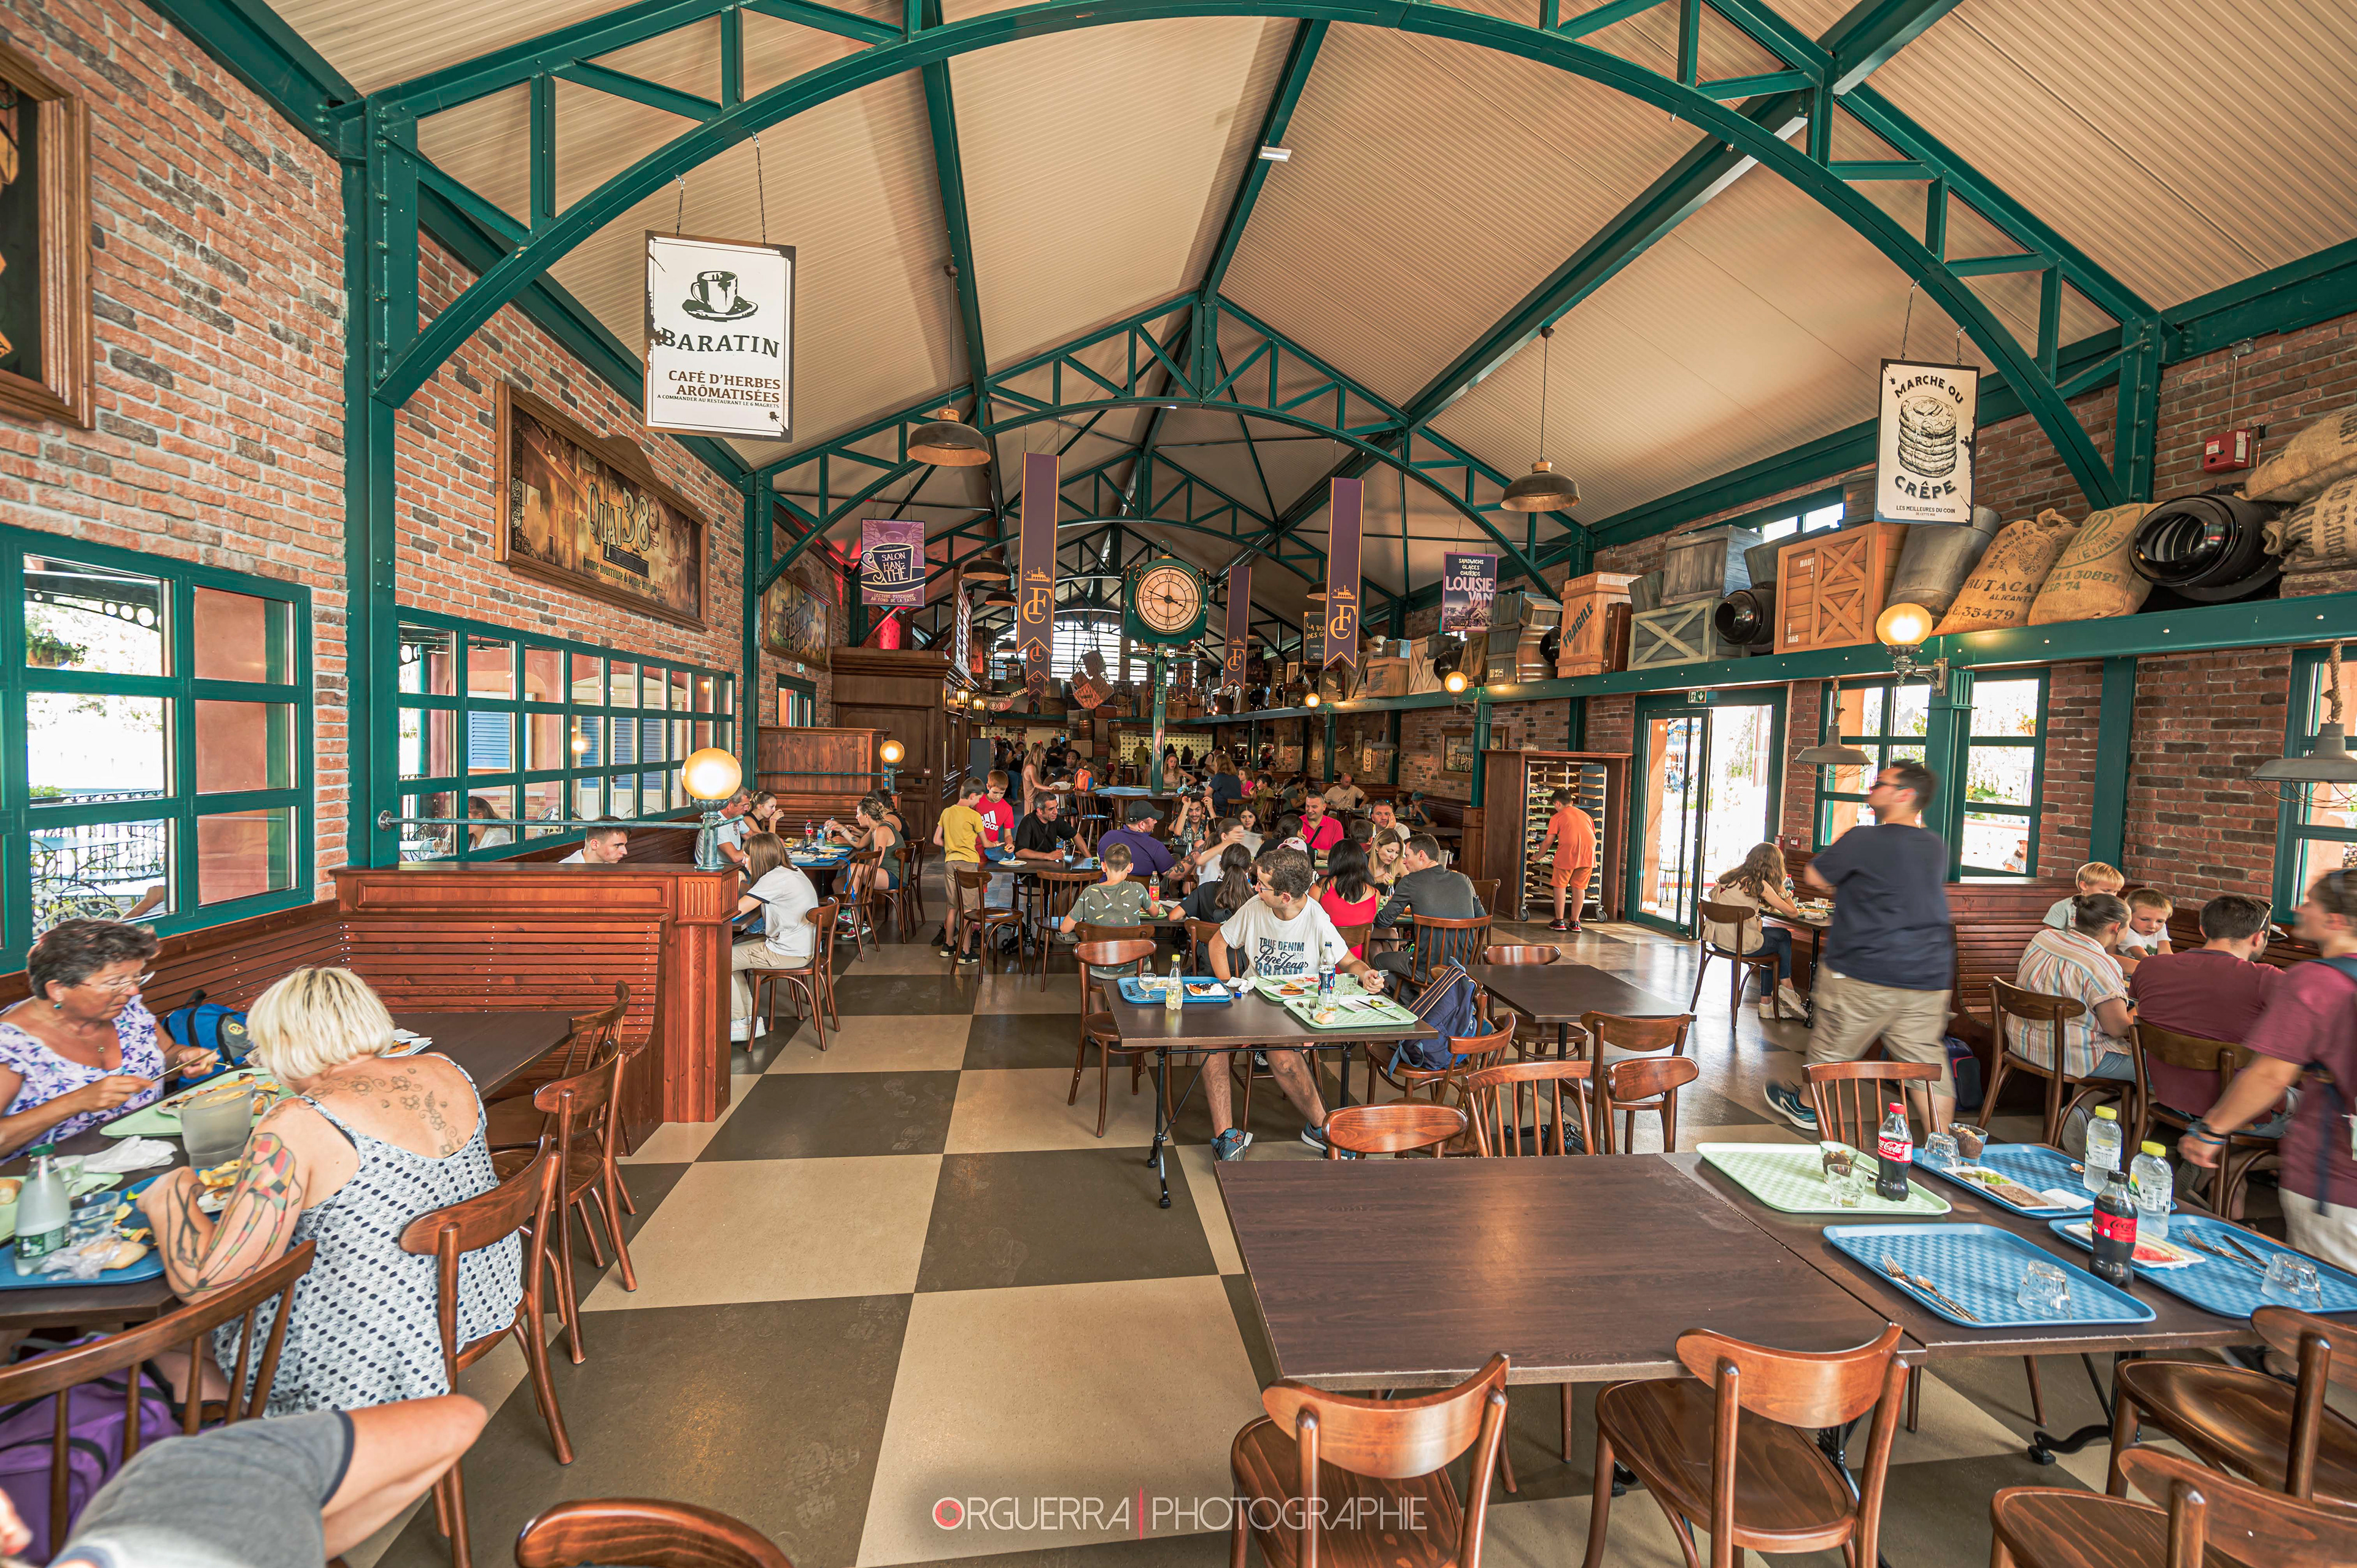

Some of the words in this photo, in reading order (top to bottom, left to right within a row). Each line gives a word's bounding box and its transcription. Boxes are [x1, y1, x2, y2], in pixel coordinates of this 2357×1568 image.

[661, 327, 780, 358] BARATIN
[668, 370, 705, 383] CAFÉ
[676, 384, 780, 403] ARÔMATISÉES
[1894, 376, 1945, 399] MARCHE
[1948, 385, 1964, 404] OU
[1895, 475, 1957, 499] CRÊPE
[587, 482, 622, 557] QUAI
[622, 487, 650, 551] 38
[881, 552, 906, 562] SALON
[584, 555, 599, 572] bonne
[600, 563, 623, 580] nourriture
[624, 572, 629, 582] &
[629, 573, 641, 588] bonne
[884, 565, 908, 582] THÉ
[1446, 576, 1495, 593] LOUISIE
[2065, 581, 2081, 591] 74
[1962, 606, 2015, 620] 35479
[1307, 622, 1314, 631] LA
[1563, 601, 1594, 648] FRAGILE
[1260, 937, 1277, 949] TRUE
[1278, 941, 1304, 952] DENIM
[1254, 945, 1282, 965] Pepe
[1274, 952, 1309, 970] Jeans
